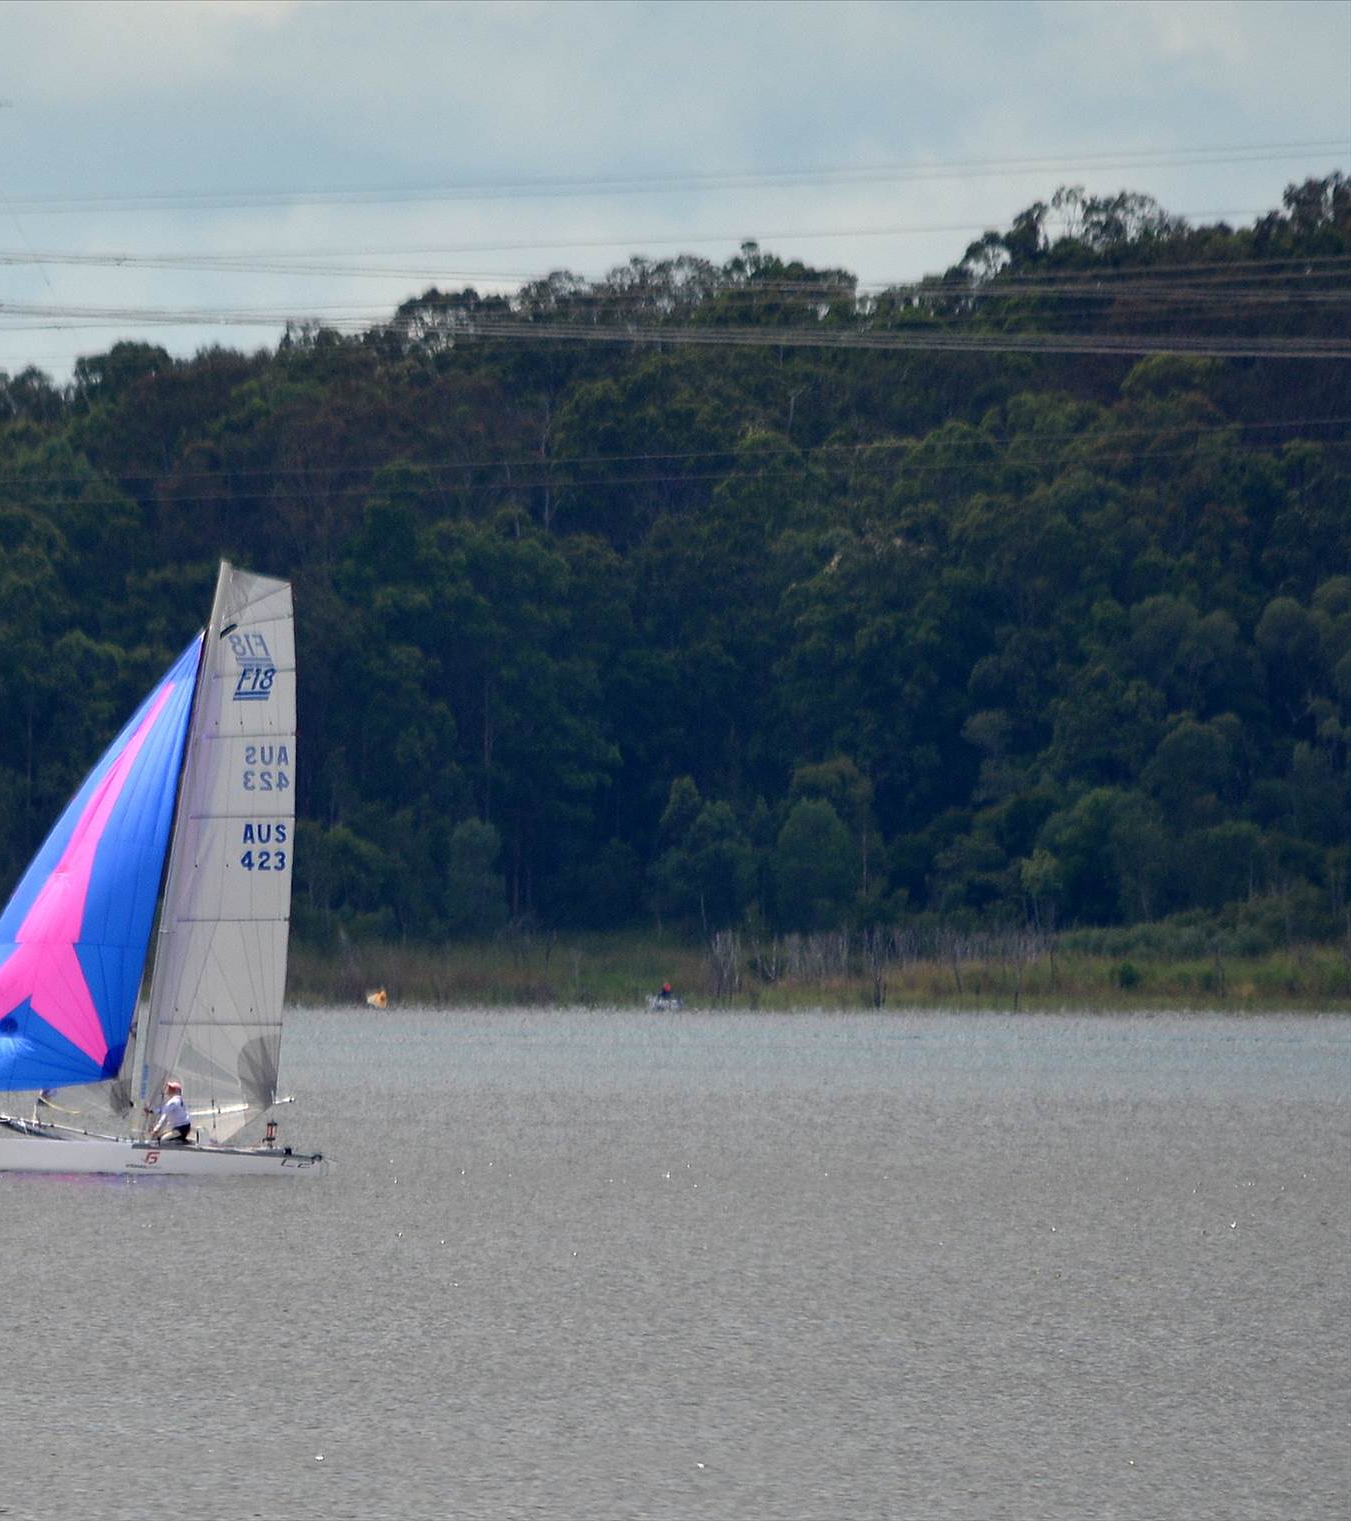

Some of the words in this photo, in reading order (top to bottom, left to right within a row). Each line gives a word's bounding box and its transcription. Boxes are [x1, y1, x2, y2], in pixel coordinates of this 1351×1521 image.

[236, 668, 276, 690] F18
[243, 824, 287, 844] AUS
[241, 851, 286, 871] 423
